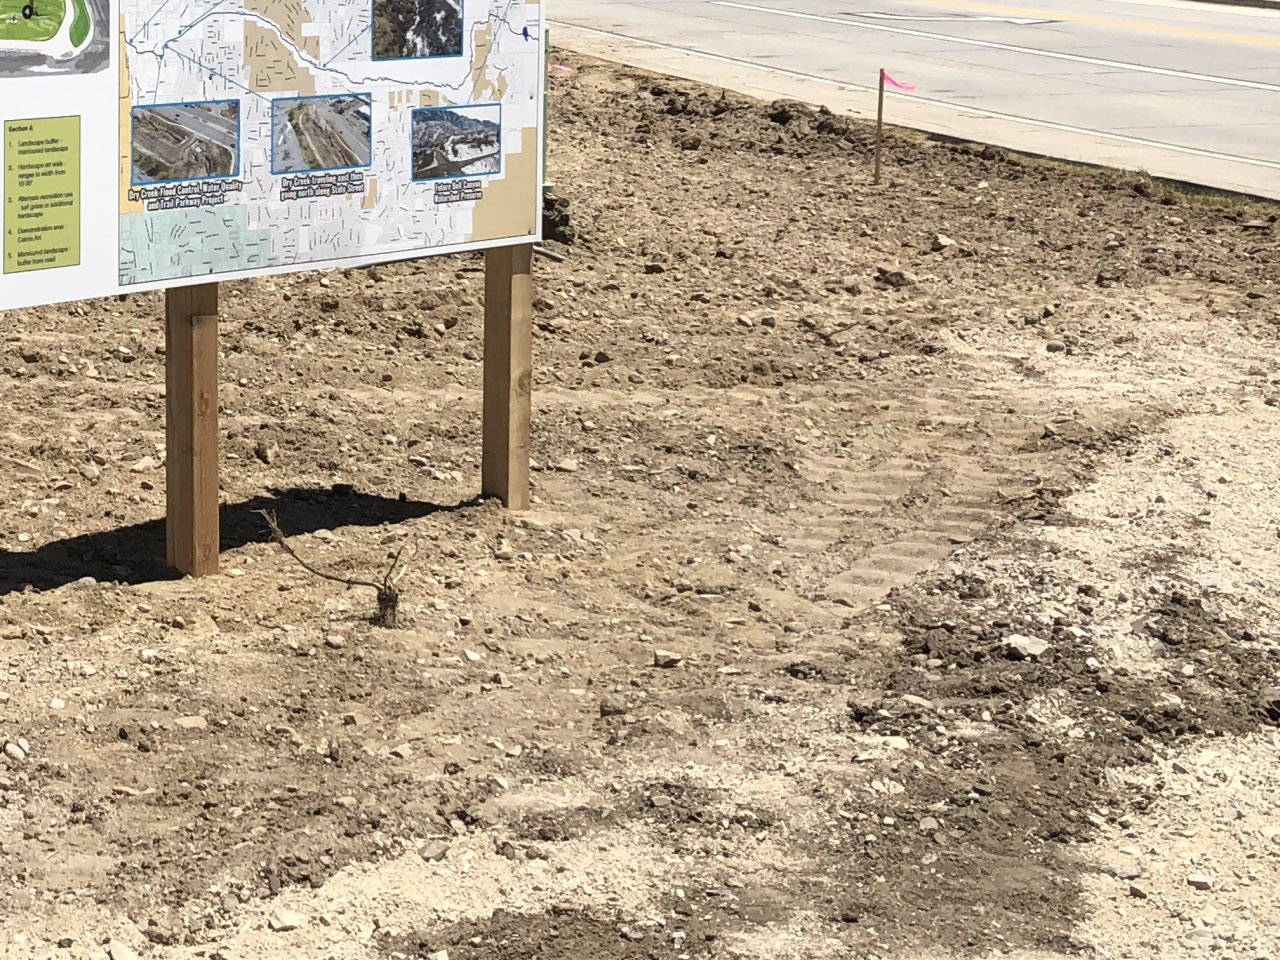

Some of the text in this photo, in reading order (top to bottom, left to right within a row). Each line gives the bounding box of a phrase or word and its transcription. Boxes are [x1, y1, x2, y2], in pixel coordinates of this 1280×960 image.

[282, 177, 293, 189] Dry
[293, 175, 311, 187] Creek
[337, 172, 350, 182] east
[128, 189, 140, 202] Dry
[140, 188, 160, 199] Creek
[160, 185, 177, 197] Flood
[202, 182, 220, 193] Water
[220, 180, 243, 192] Quality
[297, 186, 314, 198] north
[331, 183, 347, 195] State
[346, 182, 364, 194] Street
[147, 194, 224, 211] and Trail Parkway Project
